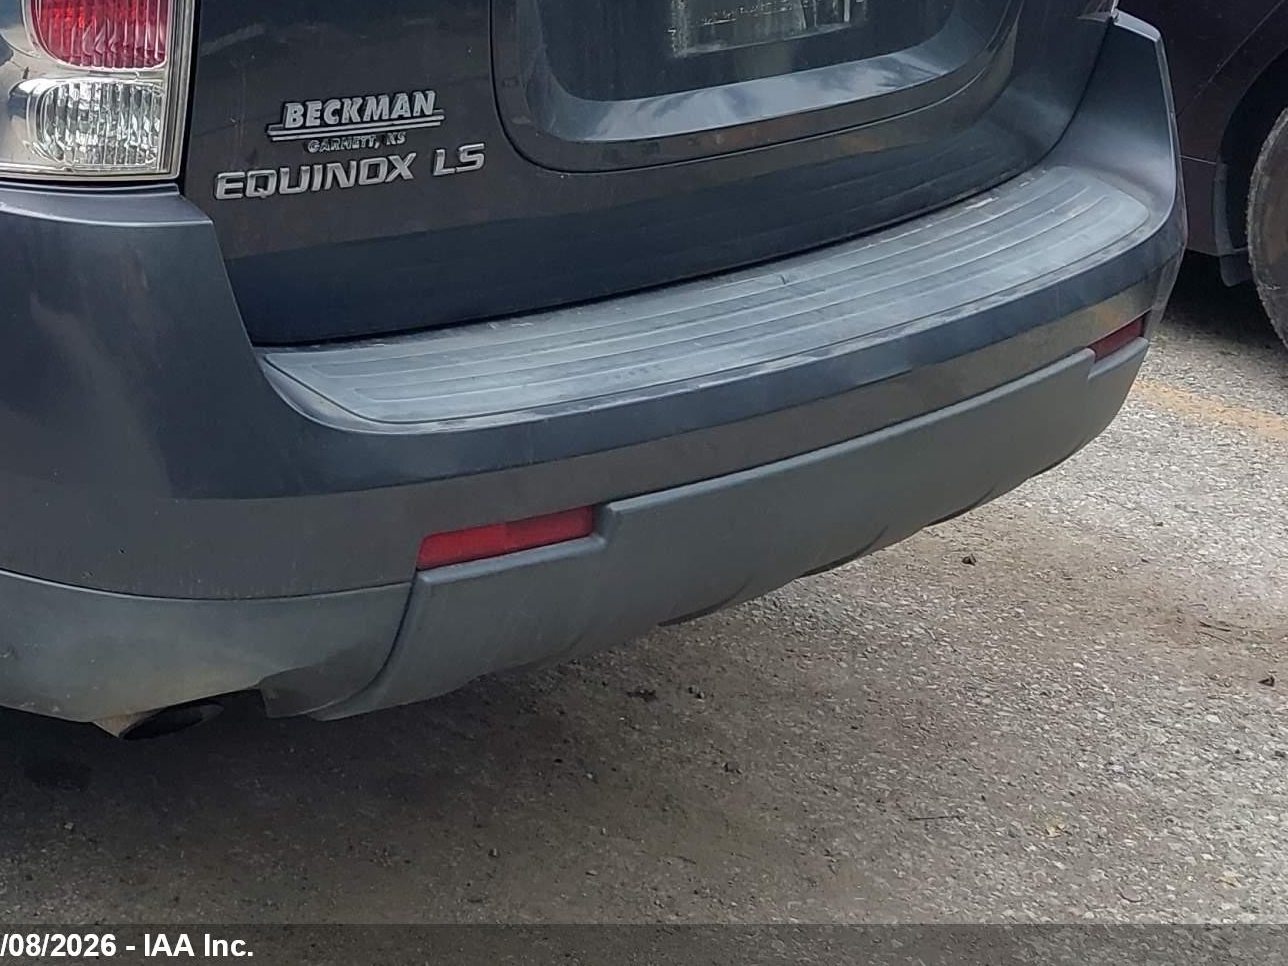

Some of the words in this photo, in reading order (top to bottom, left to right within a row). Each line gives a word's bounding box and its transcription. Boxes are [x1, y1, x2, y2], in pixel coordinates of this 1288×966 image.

[283, 90, 436, 129] BECKMAN
[386, 131, 406, 146] KS
[215, 152, 417, 201] EQUINOX
[432, 143, 485, 176] LS
